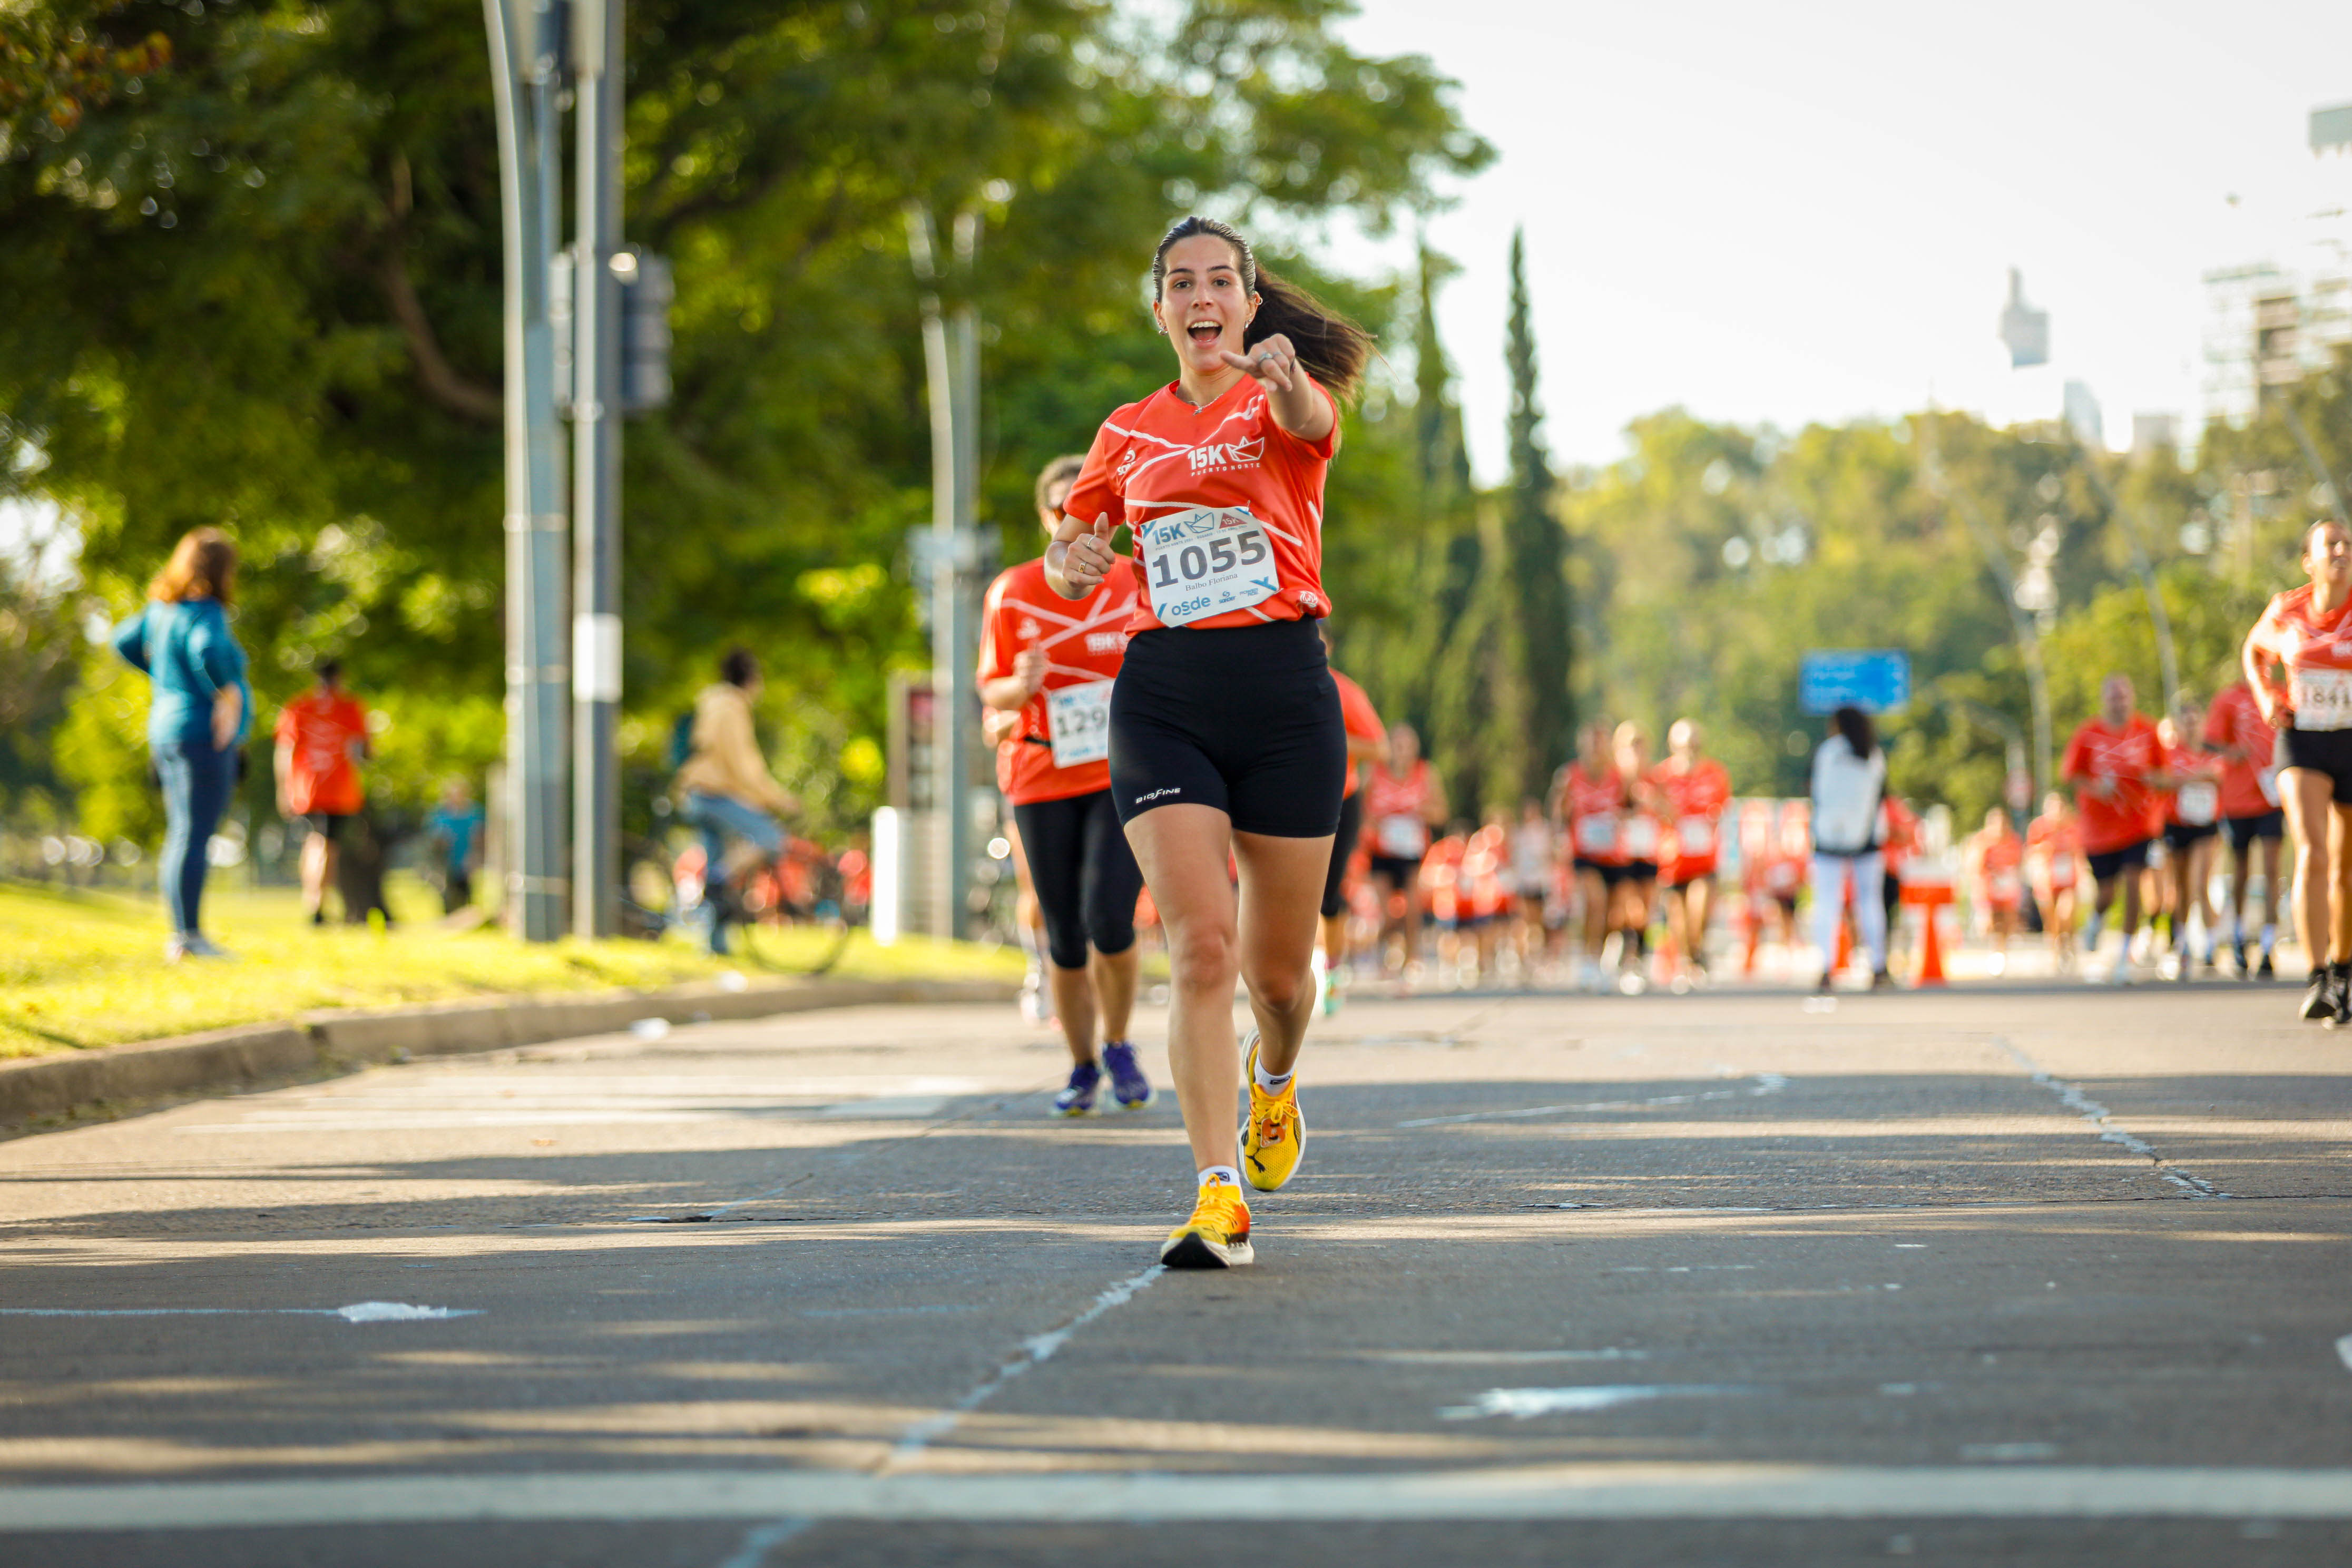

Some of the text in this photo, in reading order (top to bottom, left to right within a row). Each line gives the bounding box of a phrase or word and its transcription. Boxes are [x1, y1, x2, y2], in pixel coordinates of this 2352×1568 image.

[1188, 444, 1226, 470] 15K
[1191, 466, 1227, 476] PUERTO
[1152, 522, 1185, 545] 15K
[1152, 530, 1266, 589] 1055
[1185, 573, 1238, 591] Balbo Floriana
[1171, 596, 1211, 615] osde
